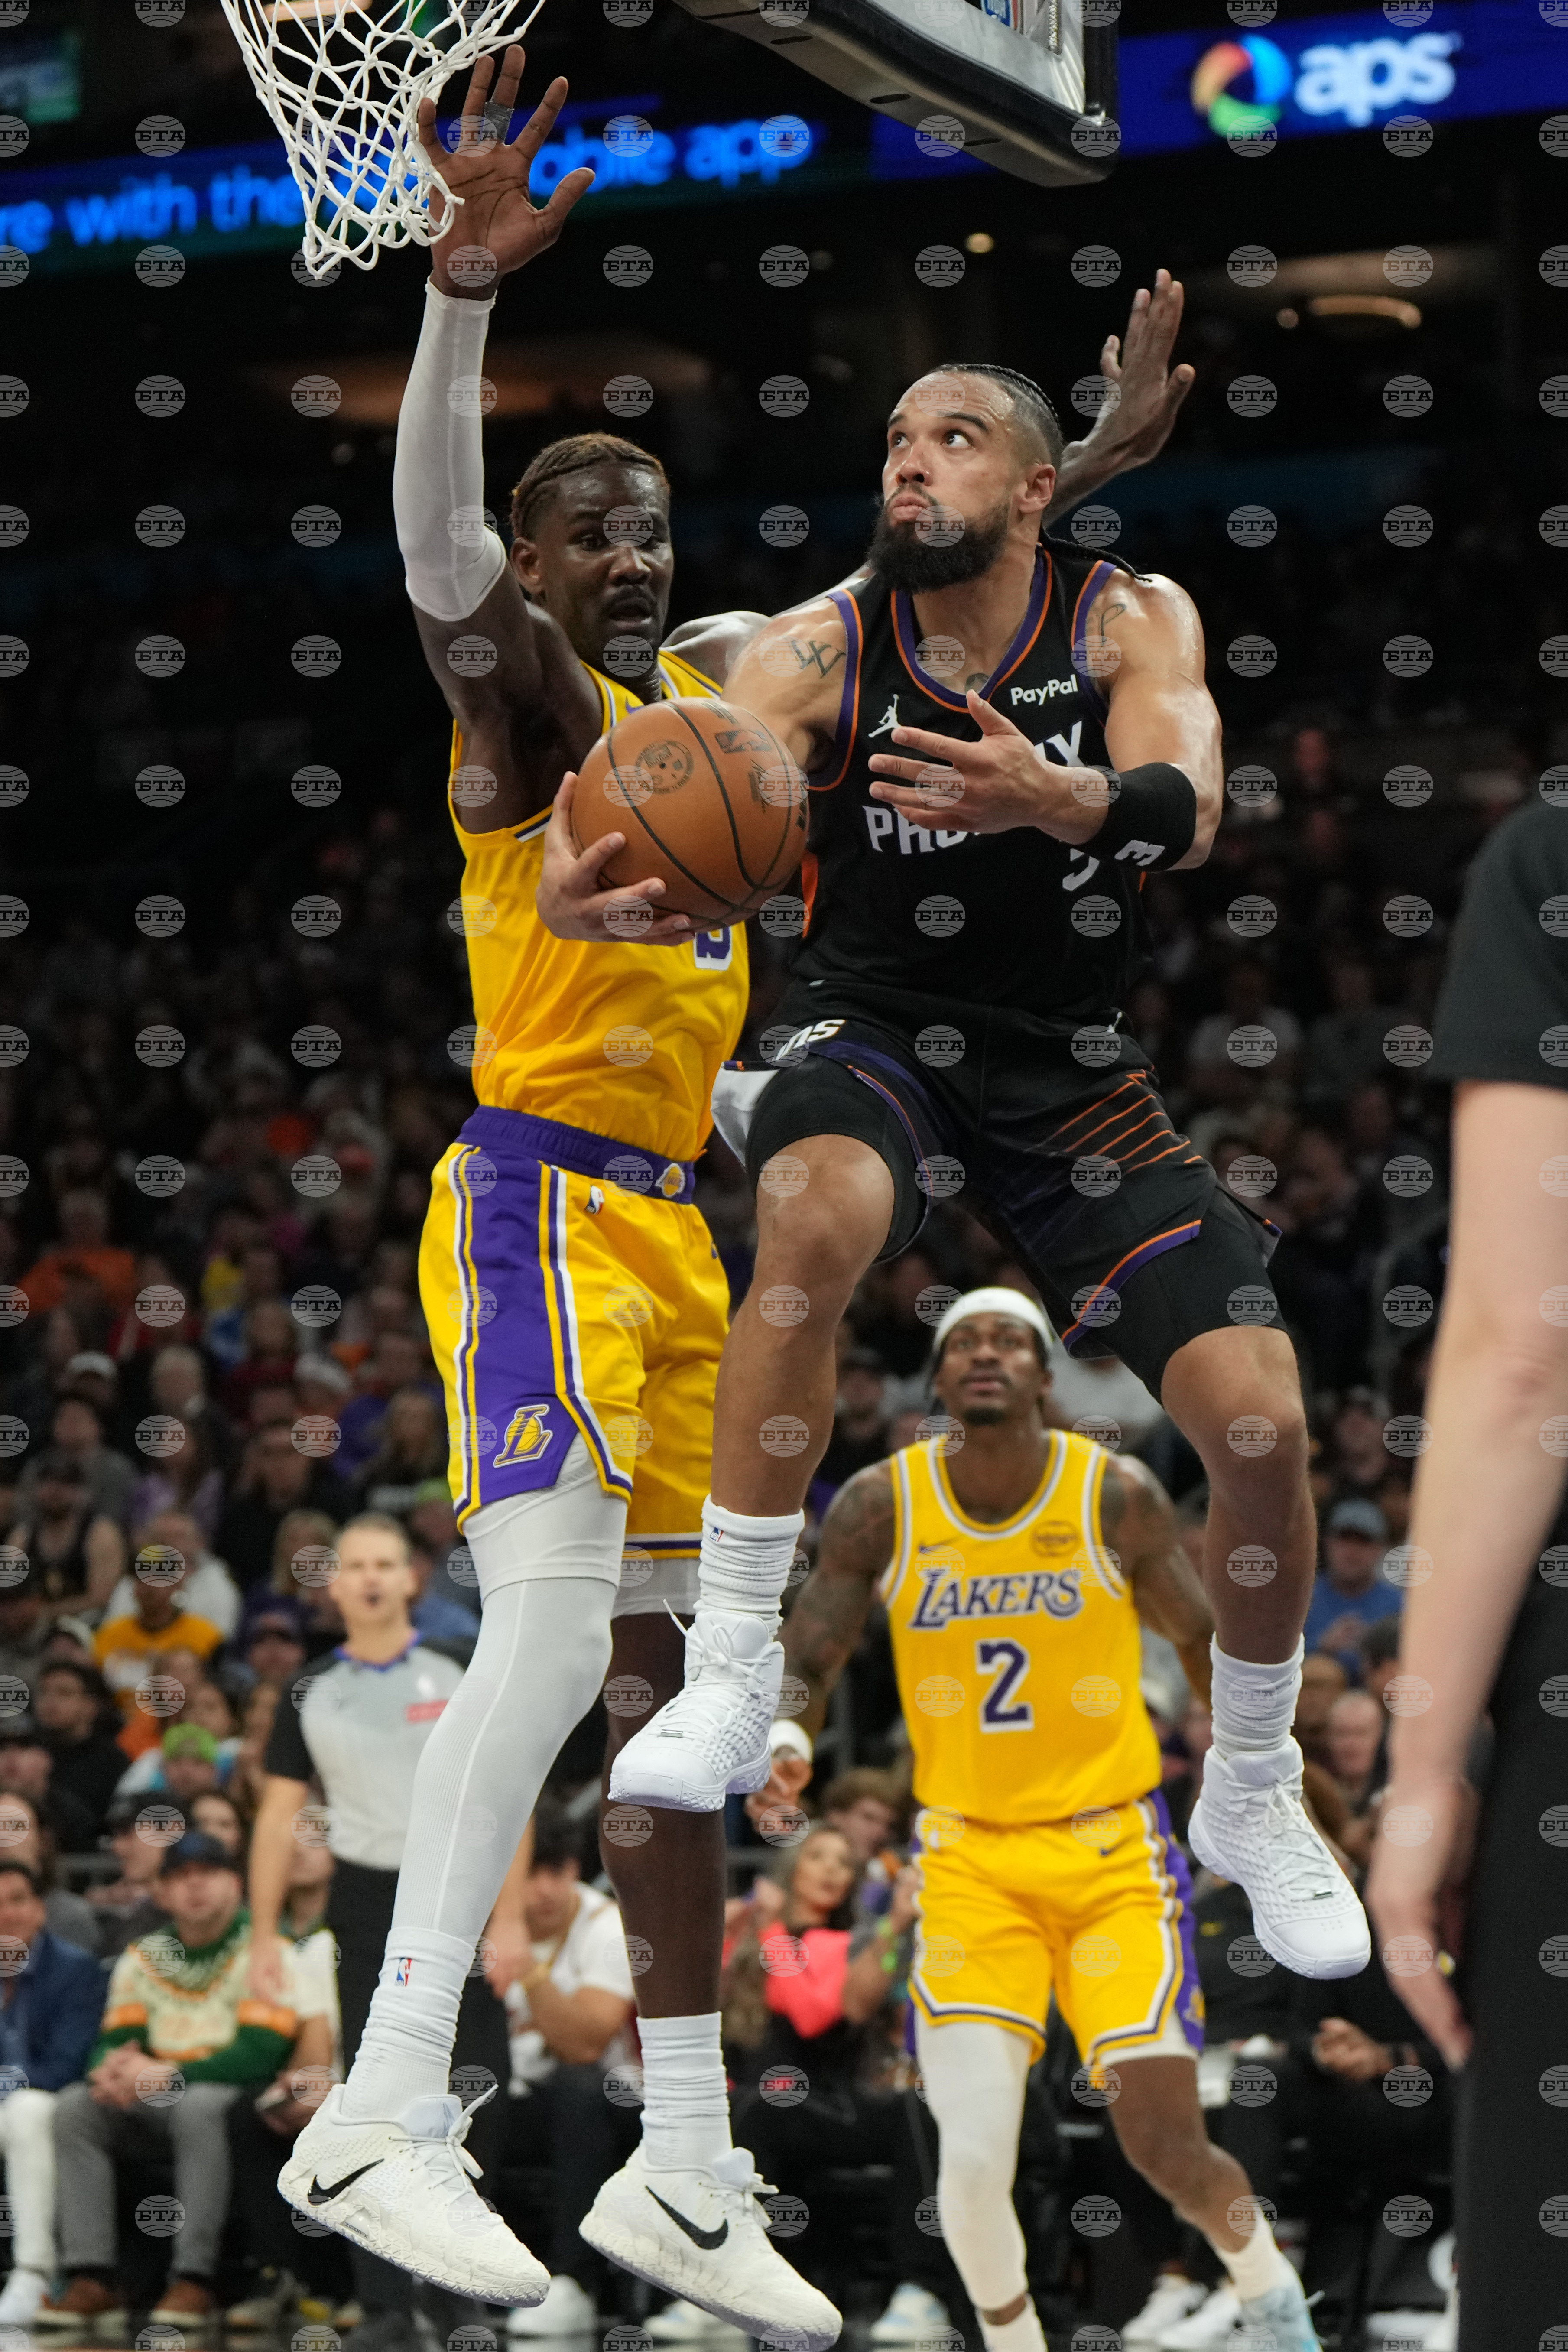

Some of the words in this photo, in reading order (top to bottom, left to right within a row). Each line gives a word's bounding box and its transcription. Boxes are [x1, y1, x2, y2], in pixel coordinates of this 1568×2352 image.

[1295, 33, 1455, 127] aps
[685, 117, 811, 188] app
[66, 172, 198, 247] with
[1010, 674, 1078, 706] PayPal
[907, 1567, 1086, 1633] LAKERS
[975, 1637, 1035, 1734] 2
